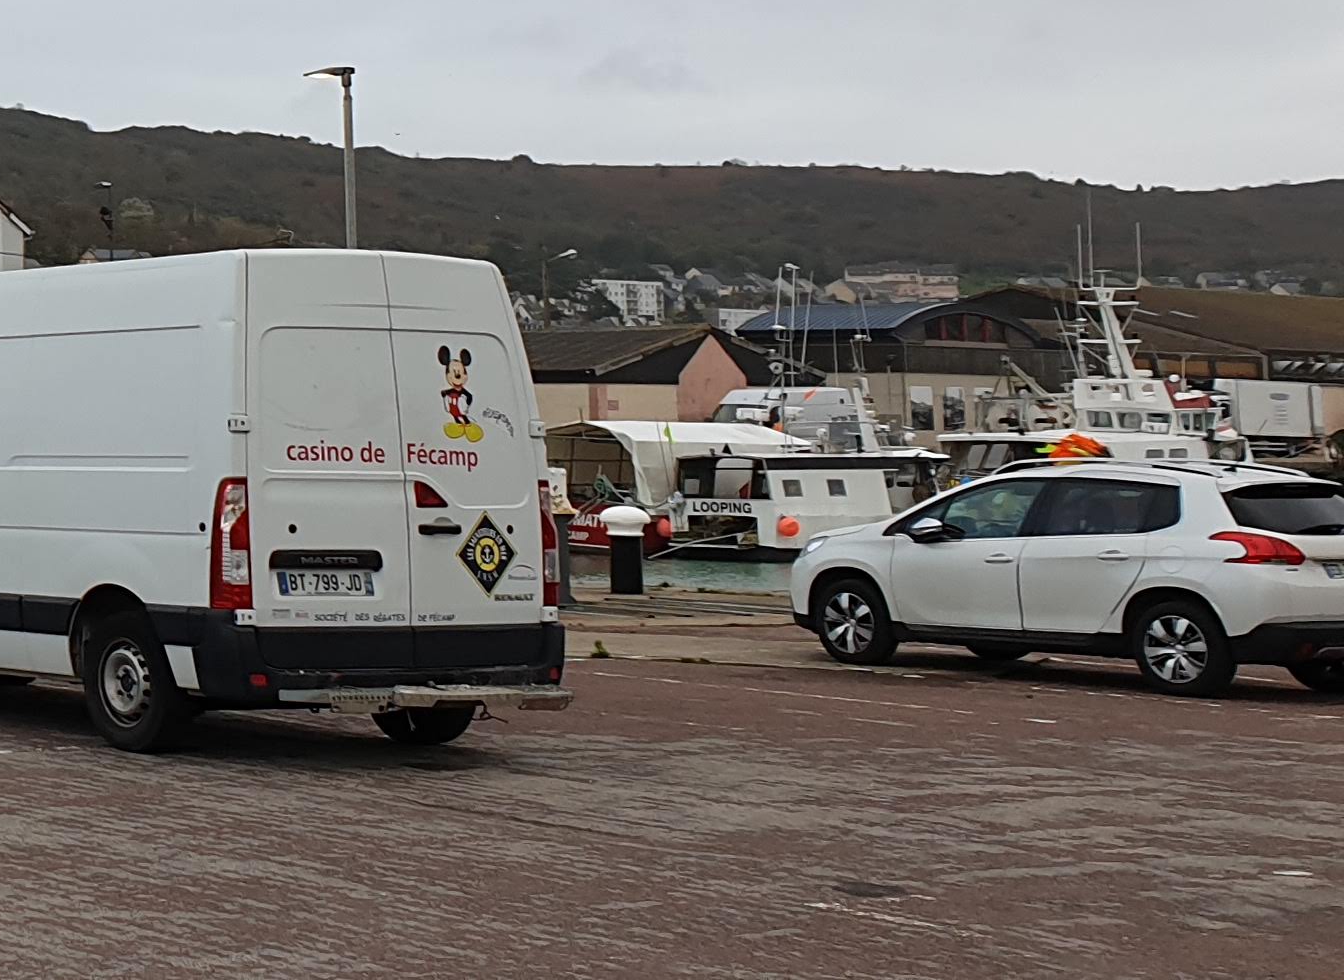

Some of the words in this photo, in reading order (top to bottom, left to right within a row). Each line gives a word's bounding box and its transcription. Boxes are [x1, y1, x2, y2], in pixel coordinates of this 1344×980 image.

[286, 440, 354, 463] casino
[360, 441, 386, 464] de
[406, 443, 479, 472] Fécamp
[692, 501, 752, 514] LOOPING
[300, 556, 359, 565] MASTER
